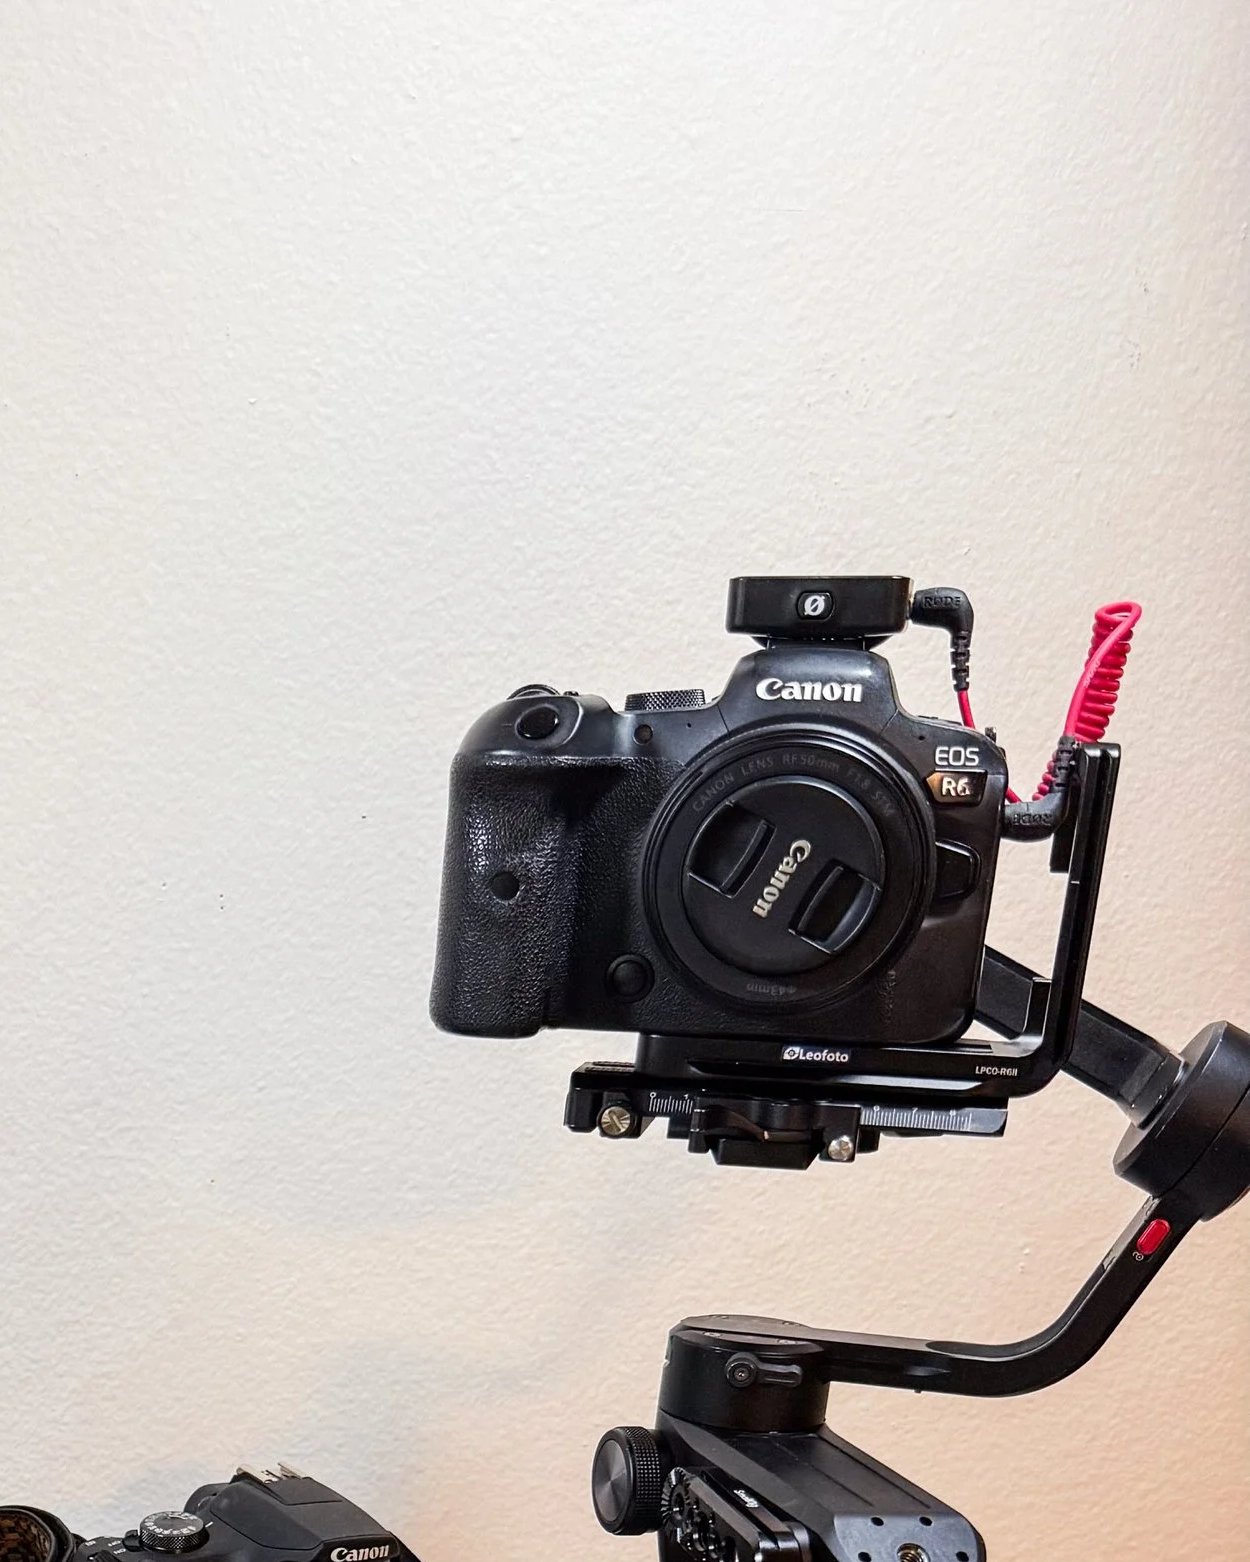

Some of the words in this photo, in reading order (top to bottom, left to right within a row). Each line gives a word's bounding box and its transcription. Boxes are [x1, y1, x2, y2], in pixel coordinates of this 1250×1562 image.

[755, 677, 863, 703] Canon
[934, 745, 980, 767] EOS
[692, 772, 735, 812] CANON
[941, 777, 972, 797] R6
[752, 839, 812, 919] Canon
[798, 1048, 849, 1063] Leofoto
[330, 1544, 390, 1562] Canon
